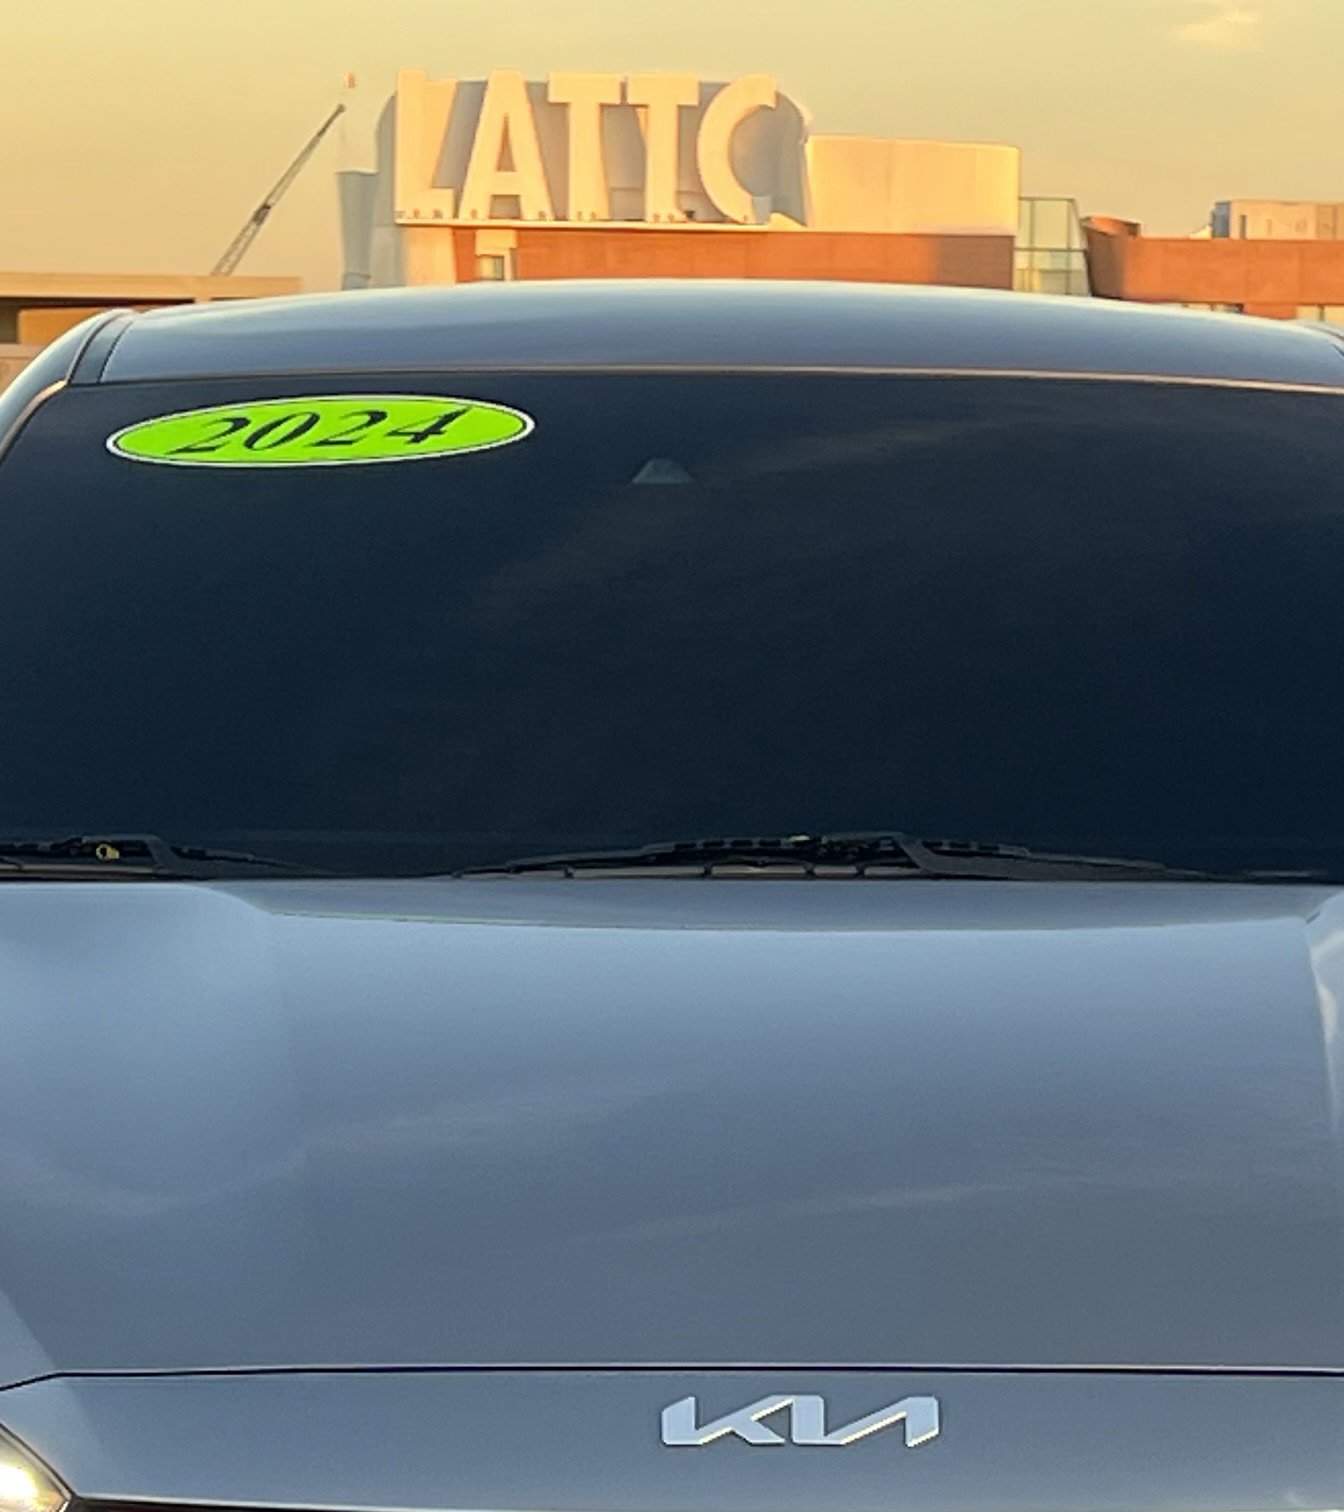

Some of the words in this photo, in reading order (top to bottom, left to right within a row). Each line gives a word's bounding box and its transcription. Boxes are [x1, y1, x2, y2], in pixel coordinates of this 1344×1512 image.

[395, 69, 778, 224] LATTC
[164, 404, 473, 456] 2024
[661, 1394, 939, 1448] KIA
